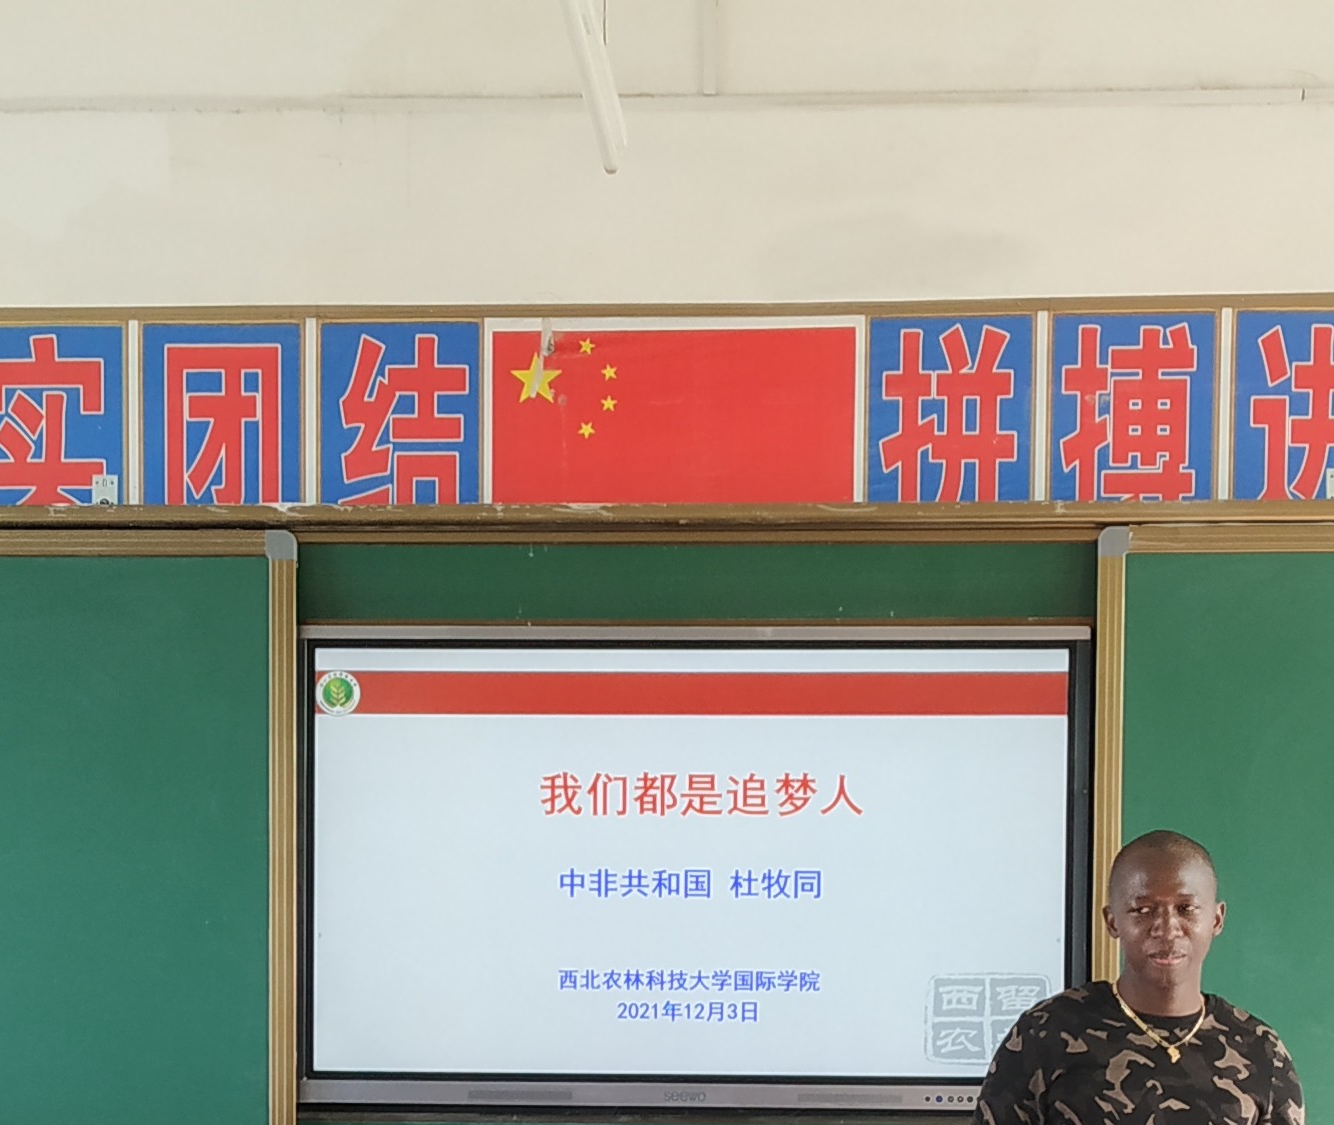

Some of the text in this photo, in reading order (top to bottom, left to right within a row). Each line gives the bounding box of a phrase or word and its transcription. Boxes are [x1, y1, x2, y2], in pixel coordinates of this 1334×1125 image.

[539, 771, 864, 817] 我们都是追梦人
[559, 867, 822, 899] 中非共和国 杜牧同
[558, 969, 821, 993] 西北农林科技大学国际学院
[616, 1000, 759, 1022] 2021年12月3日
[663, 1091, 707, 1102] seewo
